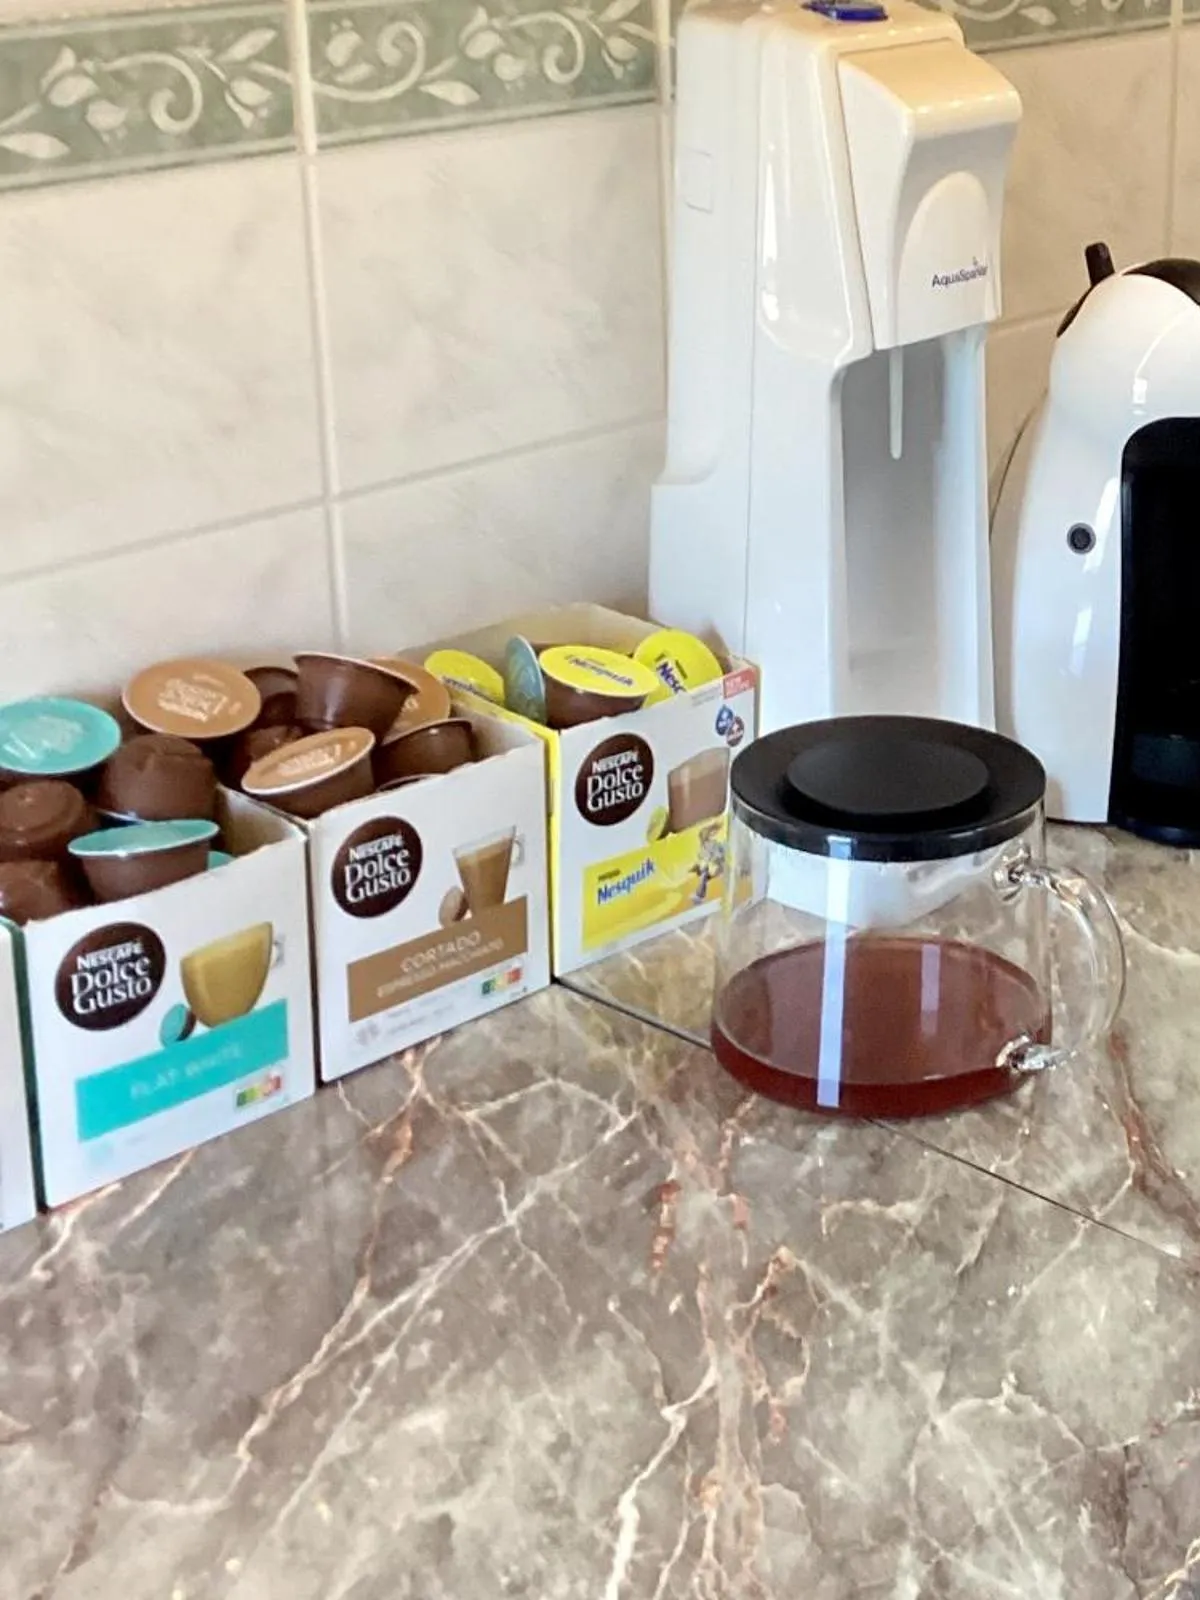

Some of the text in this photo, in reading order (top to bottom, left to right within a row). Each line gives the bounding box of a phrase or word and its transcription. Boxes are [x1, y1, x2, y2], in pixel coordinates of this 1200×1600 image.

[586, 764, 644, 800] Dolce
[587, 782, 645, 813] Gusto
[344, 848, 411, 888] Dolce
[345, 868, 412, 904] Gusto
[597, 857, 654, 906] Nesquik
[400, 930, 482, 973] CORTADO
[70, 956, 151, 997] Dolce
[72, 976, 153, 1015] Gusto
